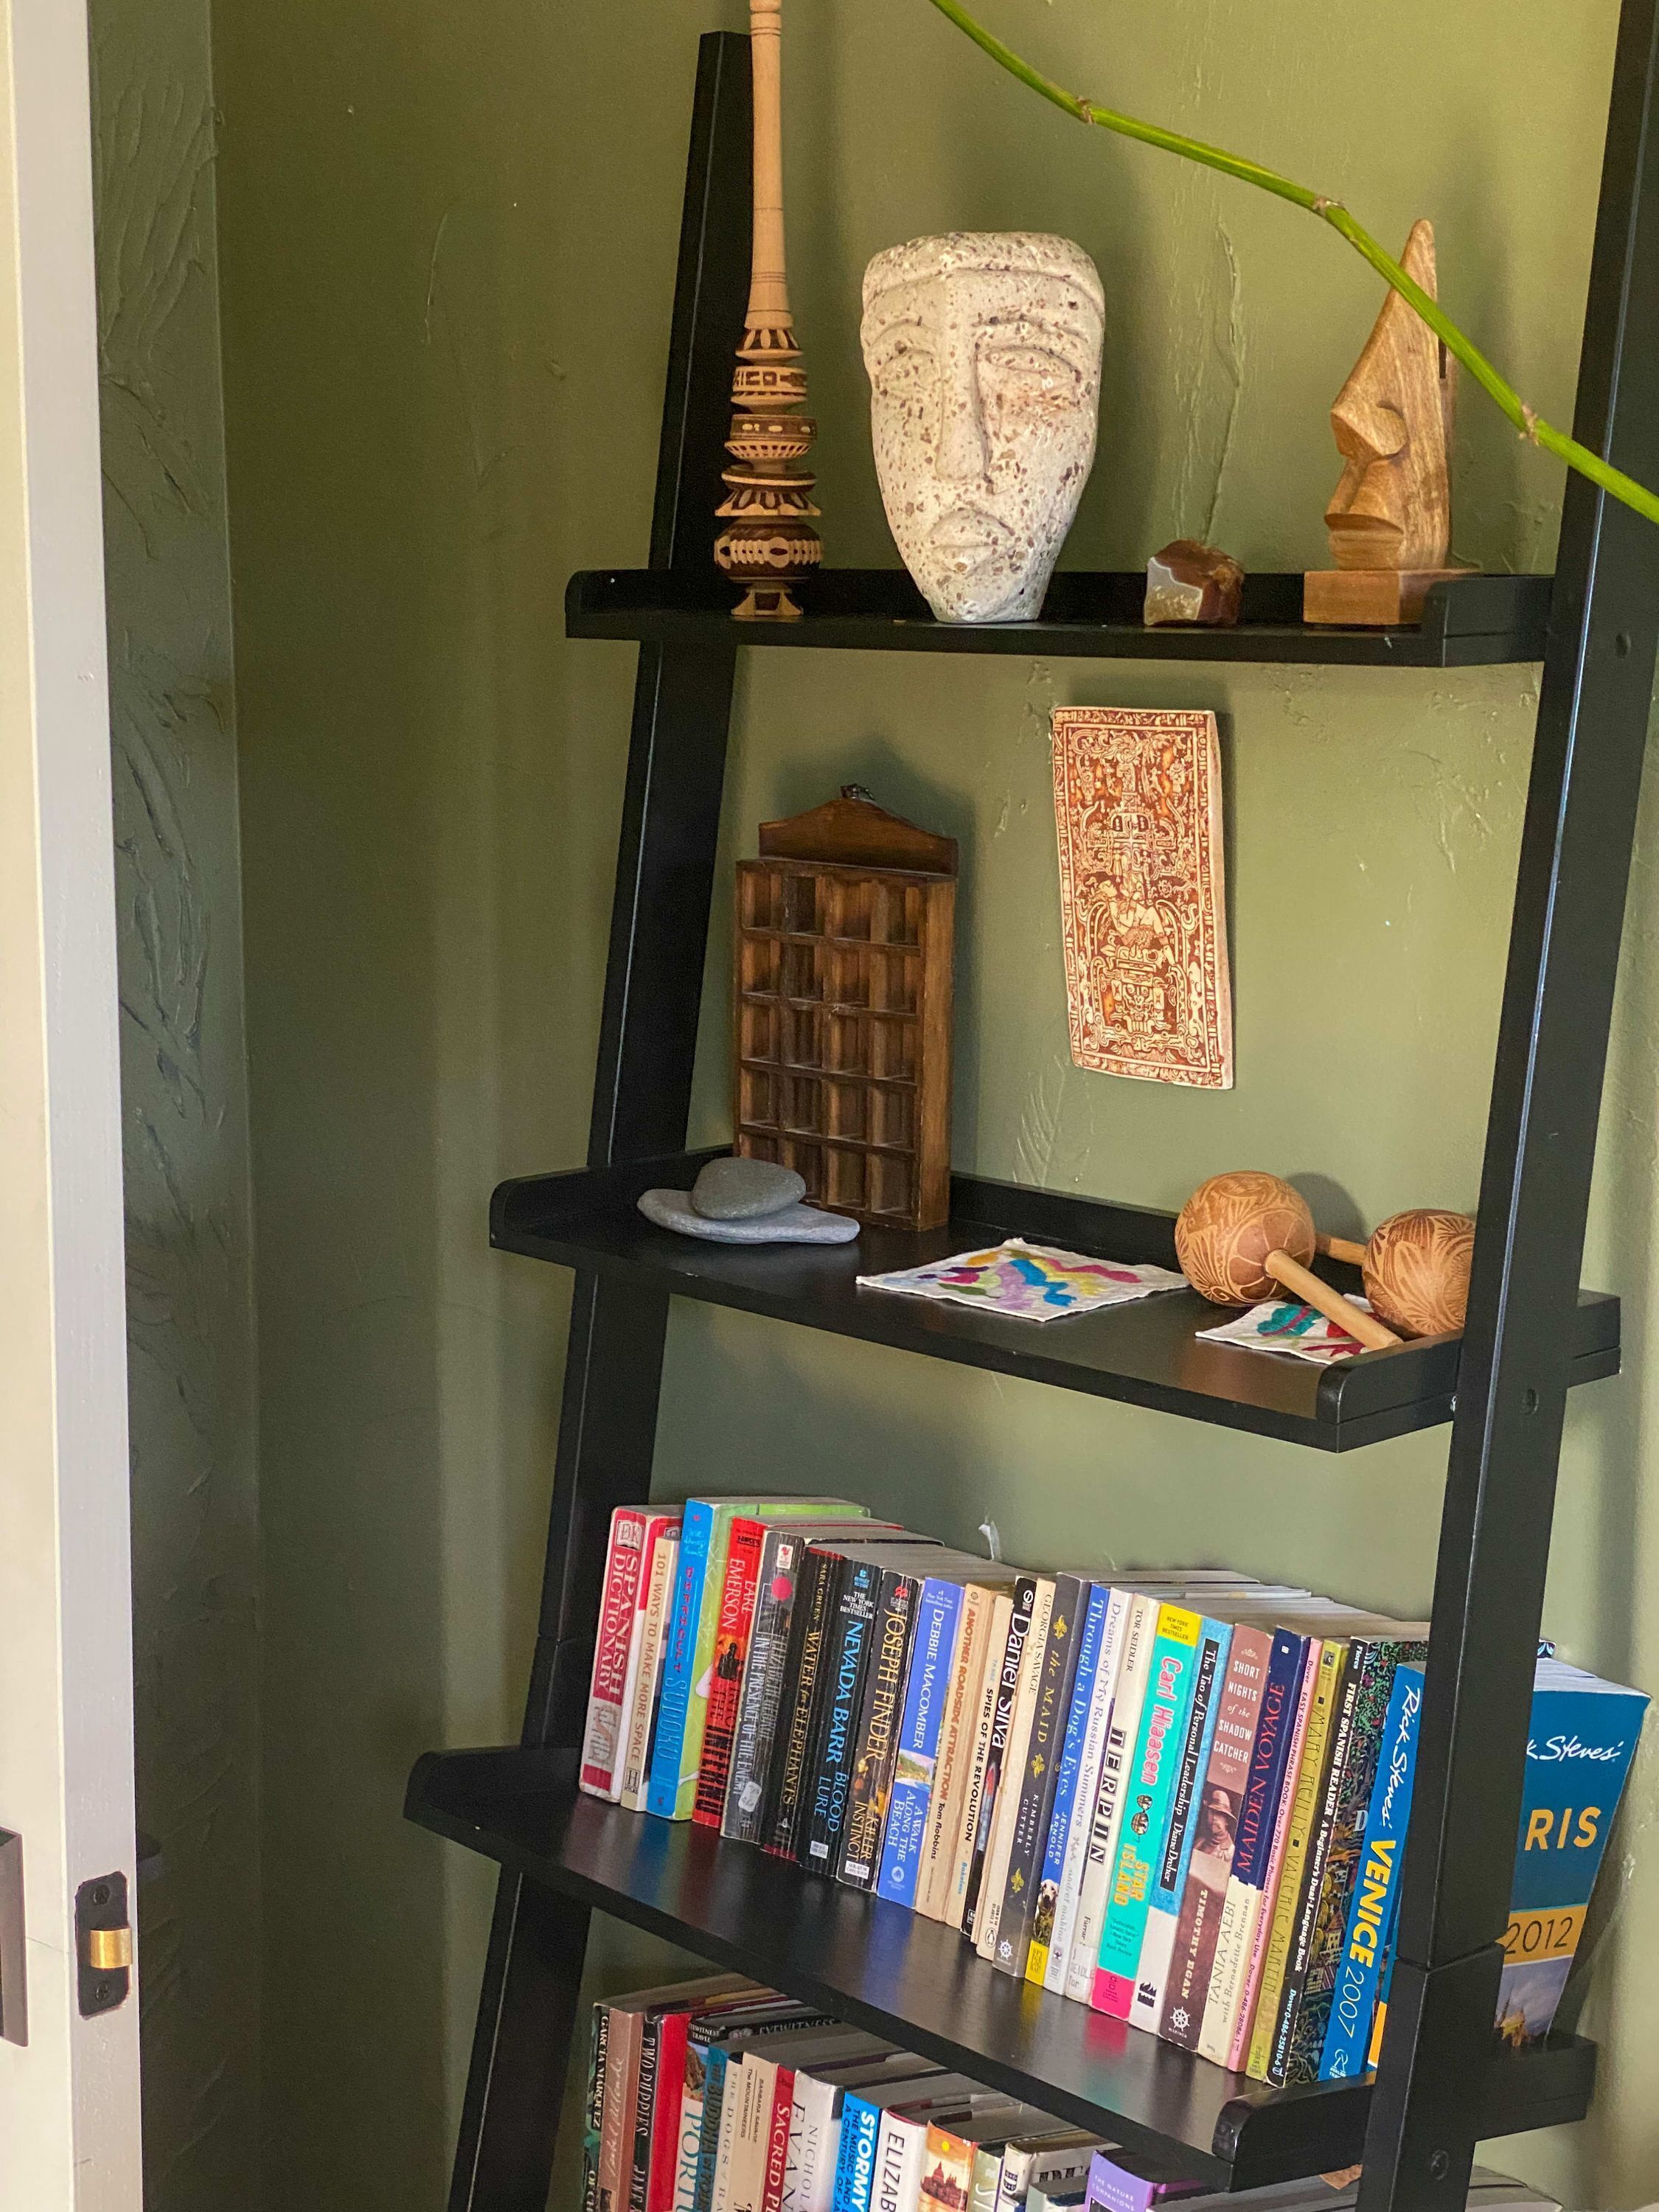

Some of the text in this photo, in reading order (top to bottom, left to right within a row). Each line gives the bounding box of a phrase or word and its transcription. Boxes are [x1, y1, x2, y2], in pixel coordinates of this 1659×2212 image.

[674, 1567, 694, 1673] DIFFICULT
[722, 1558, 745, 1630] EMERSON
[742, 1580, 756, 1613] EARL
[813, 1588, 824, 1619] GRUEN
[840, 1606, 873, 1619] BESTSELLER
[849, 1601, 866, 1611] TIMES
[599, 1553, 625, 1691] DICTIONARY
[609, 1554, 638, 1695] SPANISH
[877, 1608, 907, 1683] JOSEPH
[1029, 1594, 1052, 1694] GEORGIA SAVAGE
[1105, 1603, 1121, 1653] Dreams
[1126, 1609, 1144, 1672] TOR SEIDLER
[1162, 1628, 1189, 1641] BESTSELLER
[1170, 1624, 1183, 1632] TIMES
[631, 1554, 666, 1763] 101 WAYS TO MAKE MORE SPACE
[836, 1620, 864, 1703] NEVADA
[913, 1609, 945, 1748] DEBBIE MACOMBER
[991, 1613, 1031, 1748] Daniel Silva
[1233, 1660, 1260, 1680] SHORT
[1304, 1660, 1313, 1683] Dover
[1354, 1645, 1363, 1669] Flores
[657, 1677, 687, 1760] SUDOKU
[742, 1670, 765, 1722] PRESENCE
[784, 1632, 820, 1804] WATER ELEPHANTS
[939, 1608, 975, 1801] ANOTHER ROADSIDE ATTRACTION
[1037, 1650, 1060, 1742] the MAID
[1060, 1599, 1105, 1796] Through Dog's Eyes
[1228, 1682, 1257, 1702] NIGHTS
[1238, 1707, 1251, 1718] the
[1299, 1691, 1307, 1713] EASY
[1344, 1682, 1357, 1717] FIRST
[1396, 1685, 1421, 1744] Rick
[825, 1707, 849, 1763] BARR
[866, 1689, 895, 1761] FINDER
[1087, 1707, 1103, 1760] Russian
[1141, 1655, 1183, 1786] Carl Hiaasen
[1218, 1719, 1253, 1741] SHADOW
[1293, 1714, 1303, 1747] SPANISH
[1334, 1717, 1349, 1767] SPANISH
[695, 1725, 731, 1815] INFERNO
[965, 1688, 993, 1842] SPIES THE REVOLUTION
[1164, 1649, 1216, 1882] The Tao of Personal Leadership Diane Dreher
[1214, 1741, 1249, 1764] CATCHER
[1237, 1683, 1285, 1872] MAIDEN VOYAGE
[1287, 1748, 1297, 1779] PHRASE
[814, 1776, 831, 1818] LURE
[828, 1771, 848, 1832] BLOOD
[935, 1803, 945, 1823] Tom
[1075, 1764, 1093, 1827] Summers
[1090, 1728, 1126, 1865] TERPIN
[1324, 1767, 1341, 1816] READER
[846, 1801, 868, 1862] INSTINCT
[860, 1816, 879, 1860] KILLER
[888, 1800, 905, 1847] BEACH
[897, 1790, 916, 1863] ALONG THE
[908, 1819, 922, 1854] WALK
[931, 1823, 942, 1860] Robbins
[1016, 1798, 1029, 1844] CUTTER
[1024, 1794, 1040, 1857] KIMBERLY
[1048, 1812, 1060, 1858] ARNOLD
[1054, 1812, 1068, 1865] JENNIFER
[1272, 1828, 1281, 1844] 770
[1276, 1809, 1285, 1829] Over
[1113, 1843, 1136, 1907] ISLAND
[1264, 1711, 1326, 1994] MARY REILLY VALERIE MARTIN
[1270, 1845, 1279, 1864] Basic
[1312, 1829, 1328, 1878] Beginner's
[1130, 1860, 1149, 1902] STAR
[1265, 1865, 1275, 1894] Phrases
[1349, 1840, 1397, 1968] VENICE
[1255, 1907, 1267, 1942] Everyday
[1301, 1878, 1318, 1947] Dual-Language
[1505, 1916, 1573, 1955] 2012
[1181, 1890, 1208, 2000] TIMOTHY EGAN
[1208, 1901, 1236, 2005] TANIA AEBI
[1222, 1899, 1250, 2023] with Bernadette Brennan
[1295, 1947, 1306, 1972] Book
[1246, 1964, 1255, 1991] Dover
[1338, 1966, 1364, 2039] 2007
[641, 2037, 655, 2070] TWO
[692, 2031, 712, 2044] TRAVEL
[636, 2072, 653, 2137] PUPPIES
[740, 2081, 751, 2138] MOUNTAINEERS
[722, 2107, 734, 2165] DOGS
[770, 2103, 790, 2187] SACRED
[836, 2118, 850, 2194] CENTURY OF
[843, 2110, 860, 2203] THE MUSIC AND
[851, 2110, 876, 2212] STORMY
[630, 2164, 646, 2205] JANE
[1093, 2175, 1135, 2203] THE NATURE
[1093, 2183, 1135, 2212] COMPANIONS
